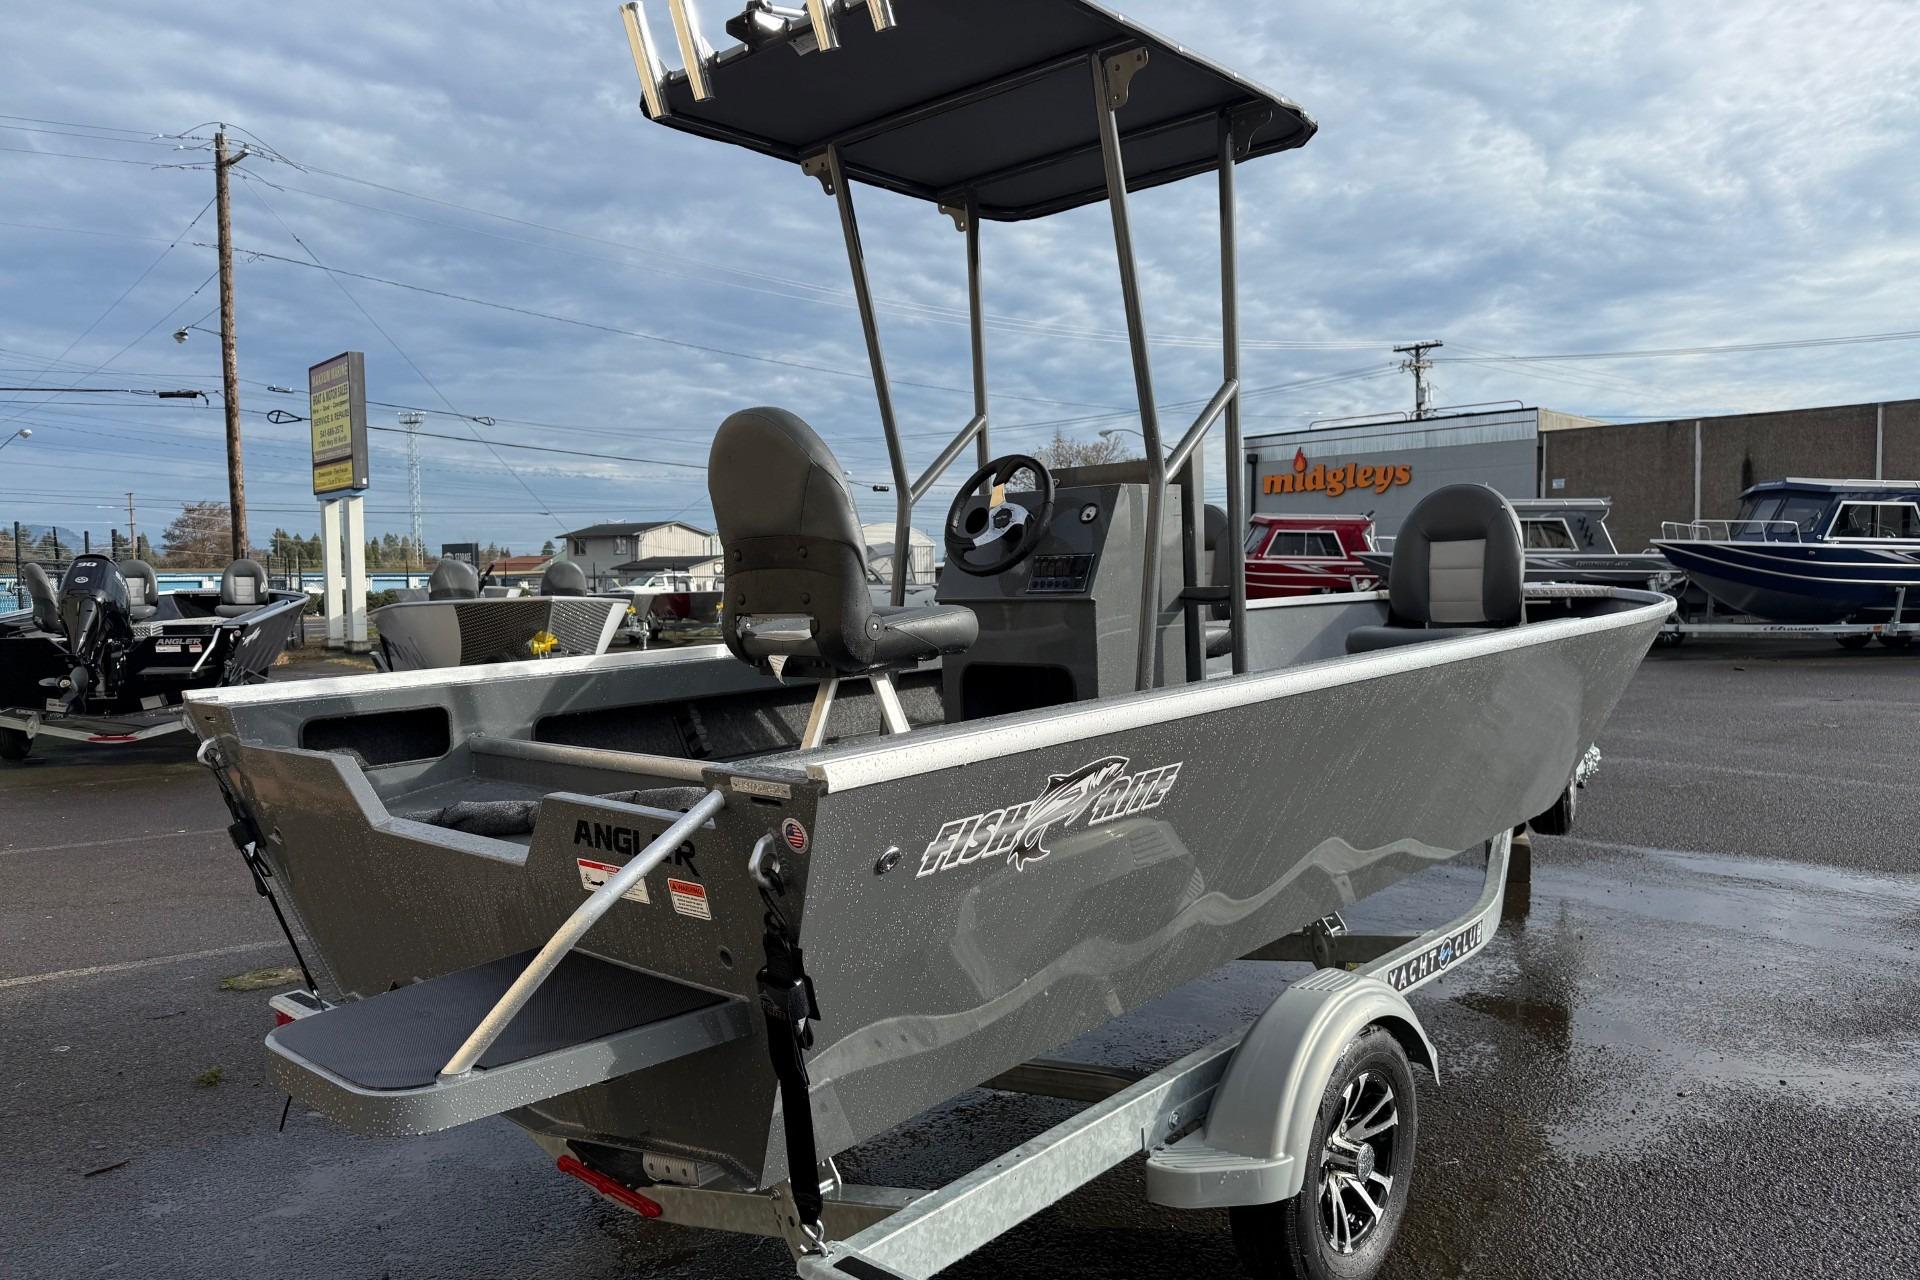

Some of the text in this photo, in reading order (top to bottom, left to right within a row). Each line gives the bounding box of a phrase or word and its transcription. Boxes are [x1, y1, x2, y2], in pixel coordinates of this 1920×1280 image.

[312, 392, 322, 406] BOAT
[326, 386, 337, 402] MOTOR
[337, 382, 348, 397] SALES
[313, 415, 330, 427] SERVICE
[1263, 462, 1412, 497] midgleys
[155, 638, 202, 649] ANGLER
[915, 761, 1184, 878] FISH RITE
[573, 819, 701, 877] ANGLR
[1388, 920, 1483, 990] YACHT CLUB
